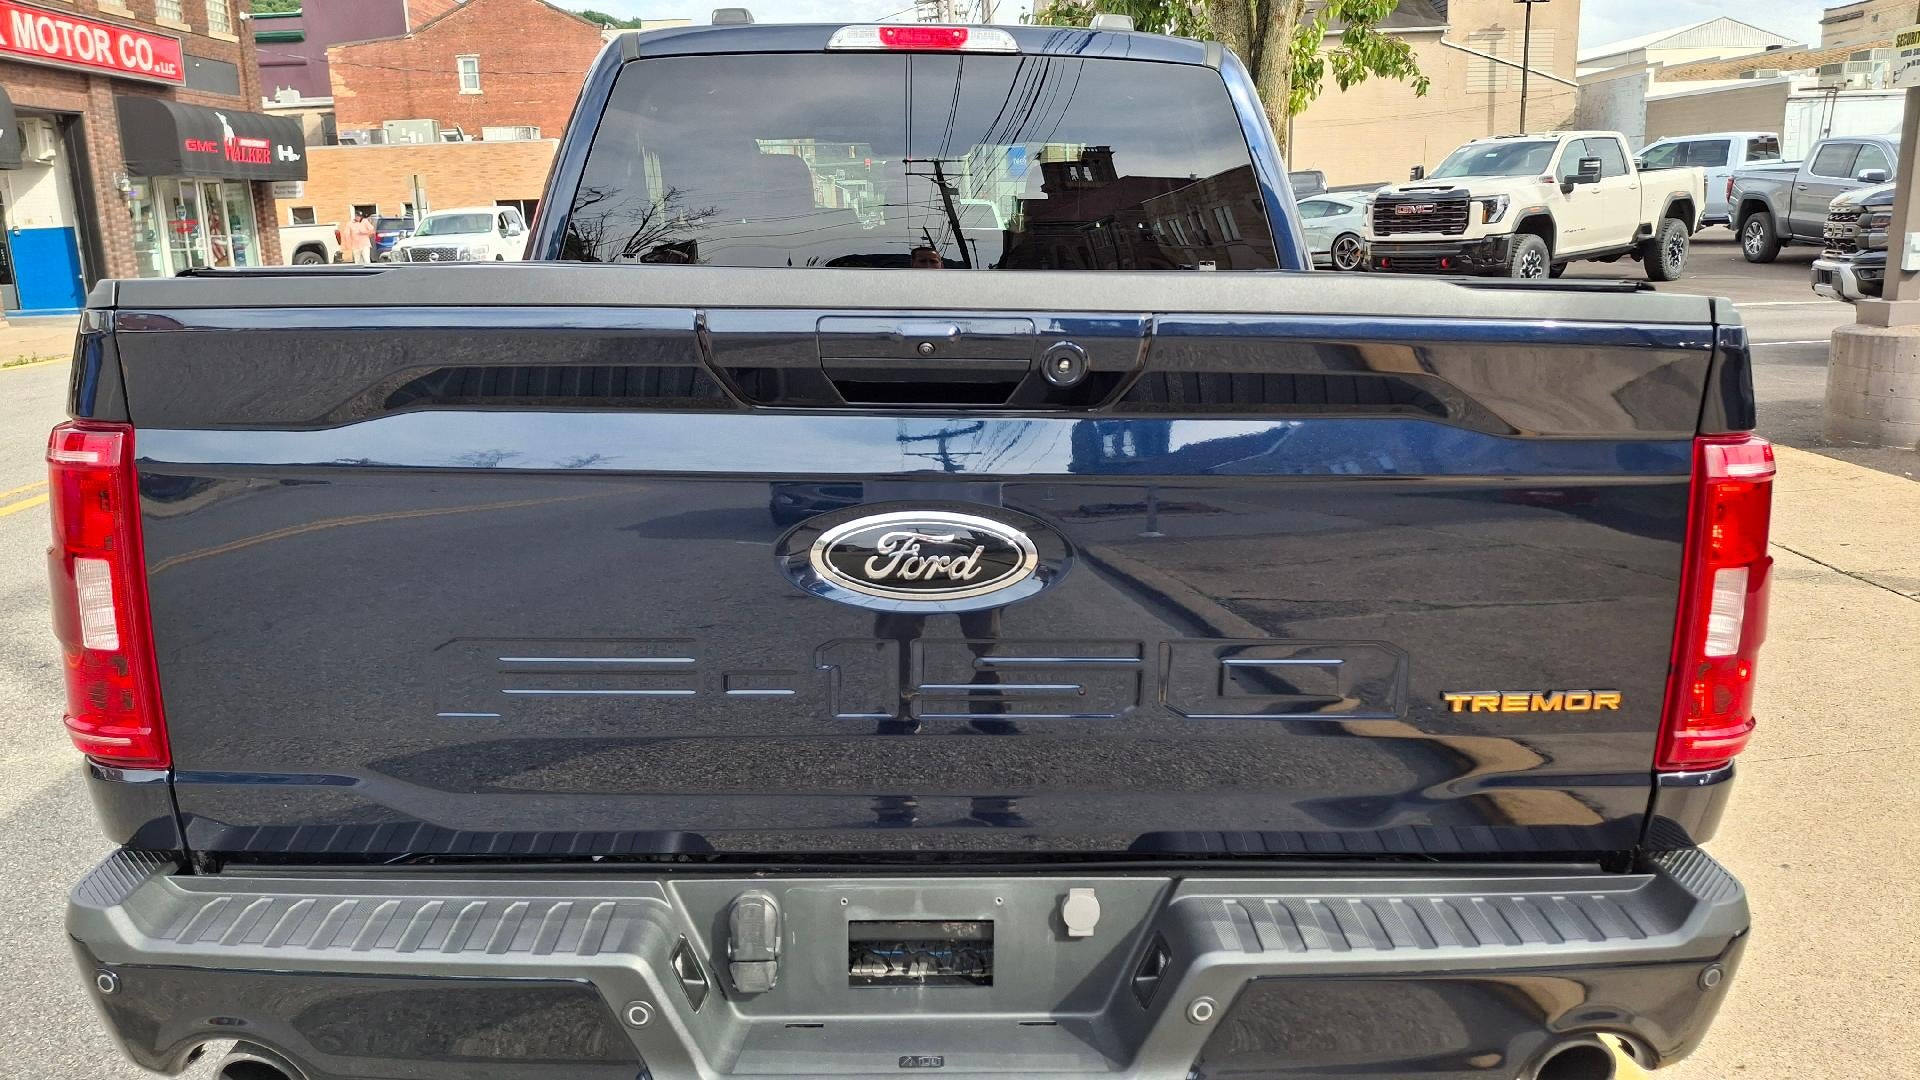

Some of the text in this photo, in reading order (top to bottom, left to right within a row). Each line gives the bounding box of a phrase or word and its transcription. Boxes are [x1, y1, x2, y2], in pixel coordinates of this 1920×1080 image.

[11, 10, 176, 75] MOTOR CO. LLC
[185, 139, 218, 153] GMC
[223, 136, 272, 164] WALKER
[1396, 203, 1436, 214] GMC
[864, 531, 985, 581] Ford
[434, 637, 1410, 720] F-150
[1440, 689, 1623, 712] TREMOR
